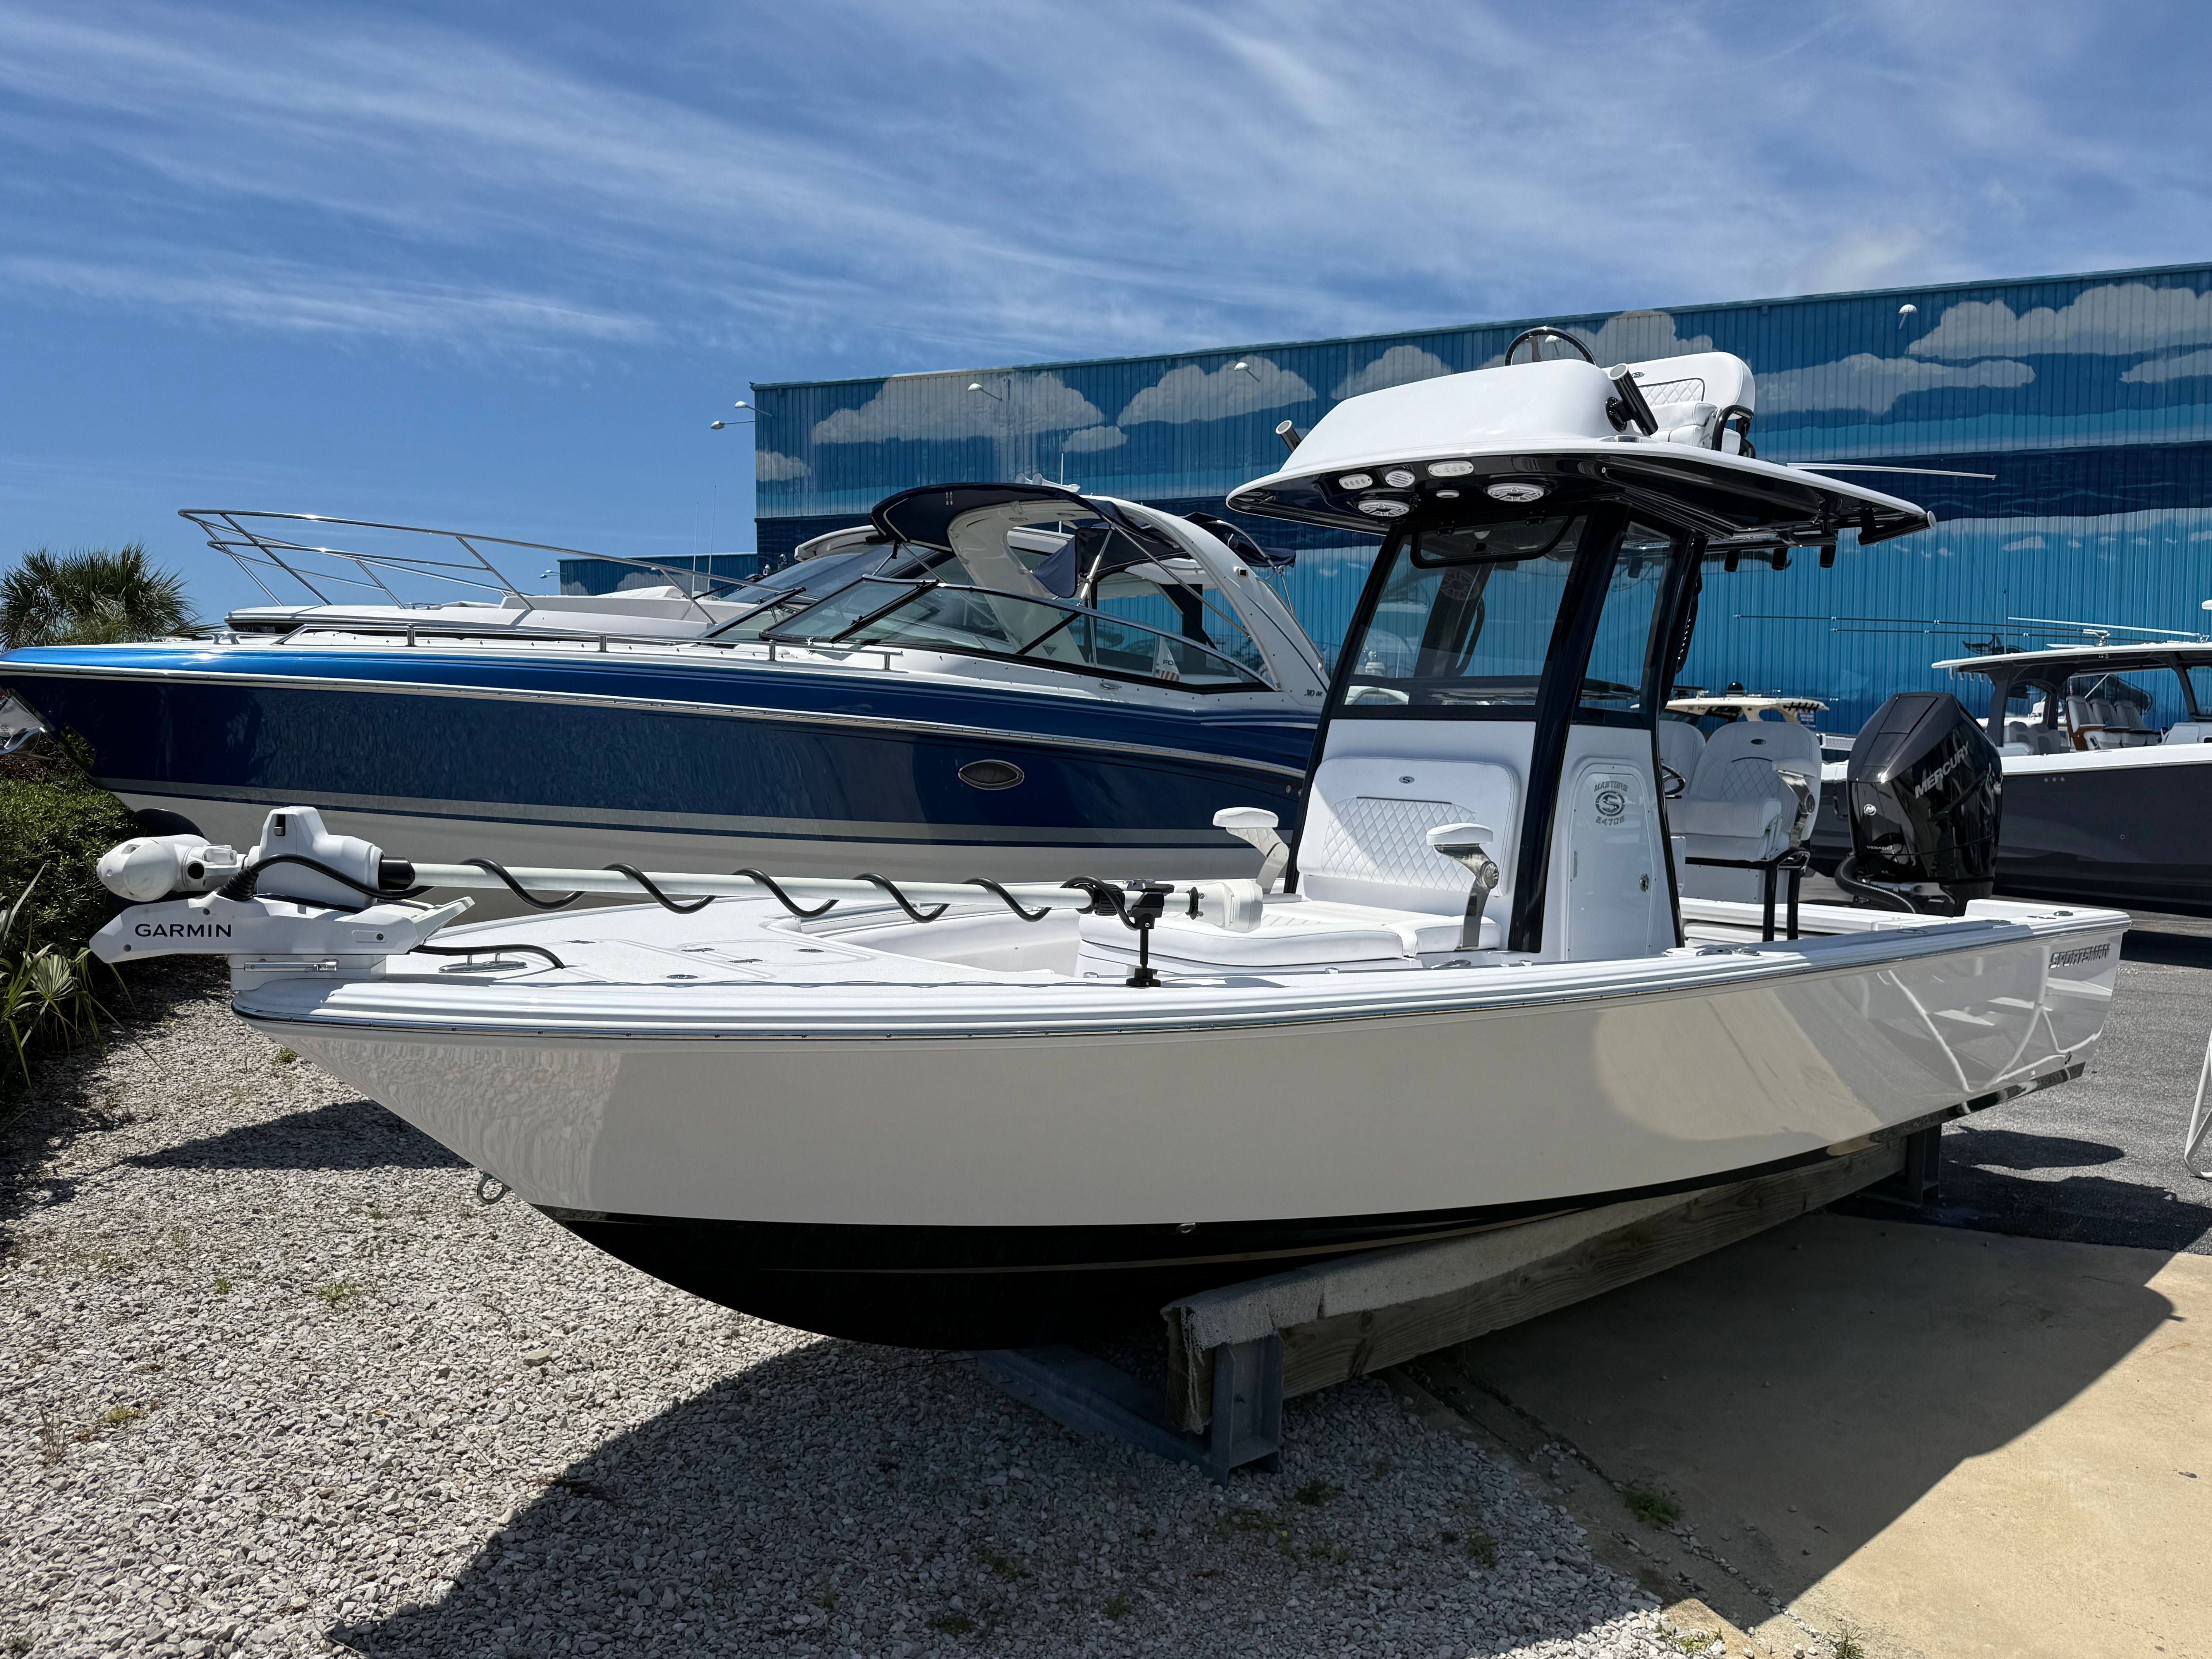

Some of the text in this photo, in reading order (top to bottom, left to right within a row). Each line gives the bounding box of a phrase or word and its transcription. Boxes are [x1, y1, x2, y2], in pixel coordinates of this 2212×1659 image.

[1915, 740, 1969, 799] MERCURY
[1594, 780, 1628, 792] MASTERS
[135, 923, 231, 937] GARMIN
[2049, 943, 2110, 969] SPORTSMAN
